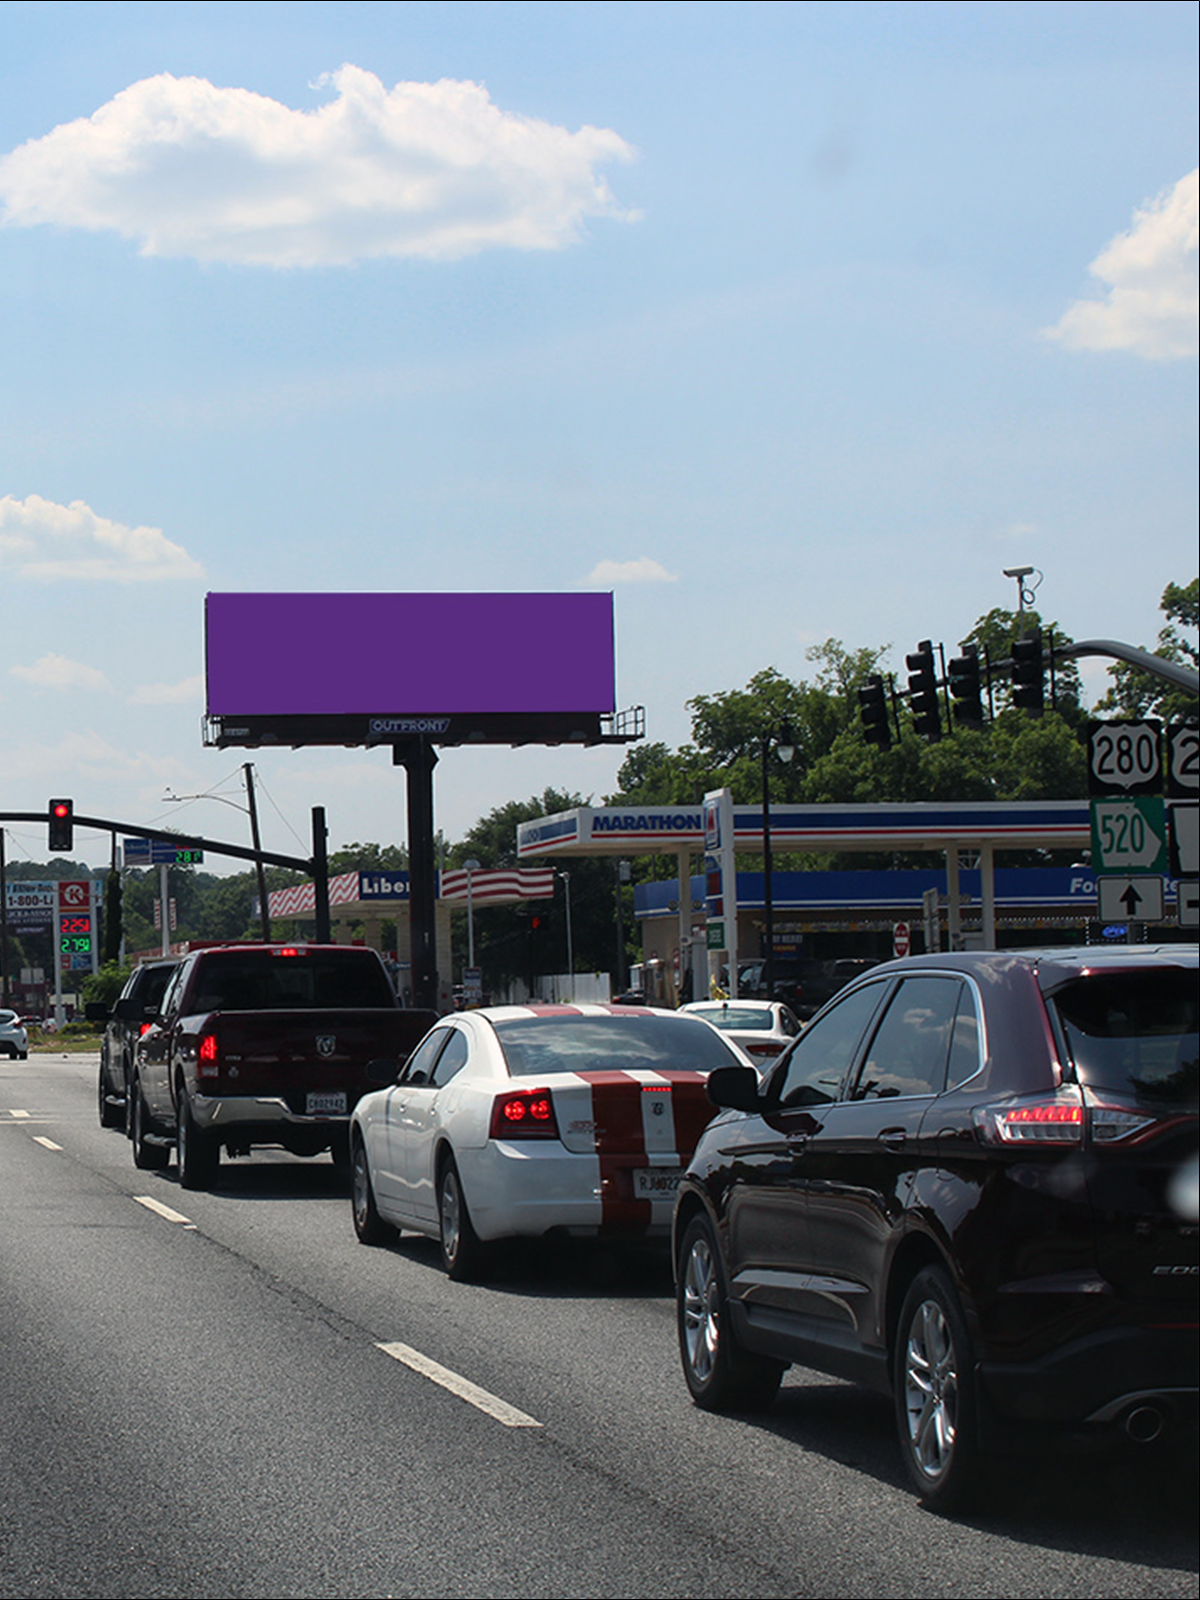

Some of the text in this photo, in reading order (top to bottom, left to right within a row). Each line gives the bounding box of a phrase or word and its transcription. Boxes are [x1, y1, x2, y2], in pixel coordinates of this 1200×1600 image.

[373, 720, 445, 732] OUTFRONT
[1097, 734, 1153, 775] 280
[1179, 735, 1199, 776] 2
[592, 814, 701, 831] MARATHON
[1102, 814, 1144, 854] 520
[362, 877, 410, 893] Liber
